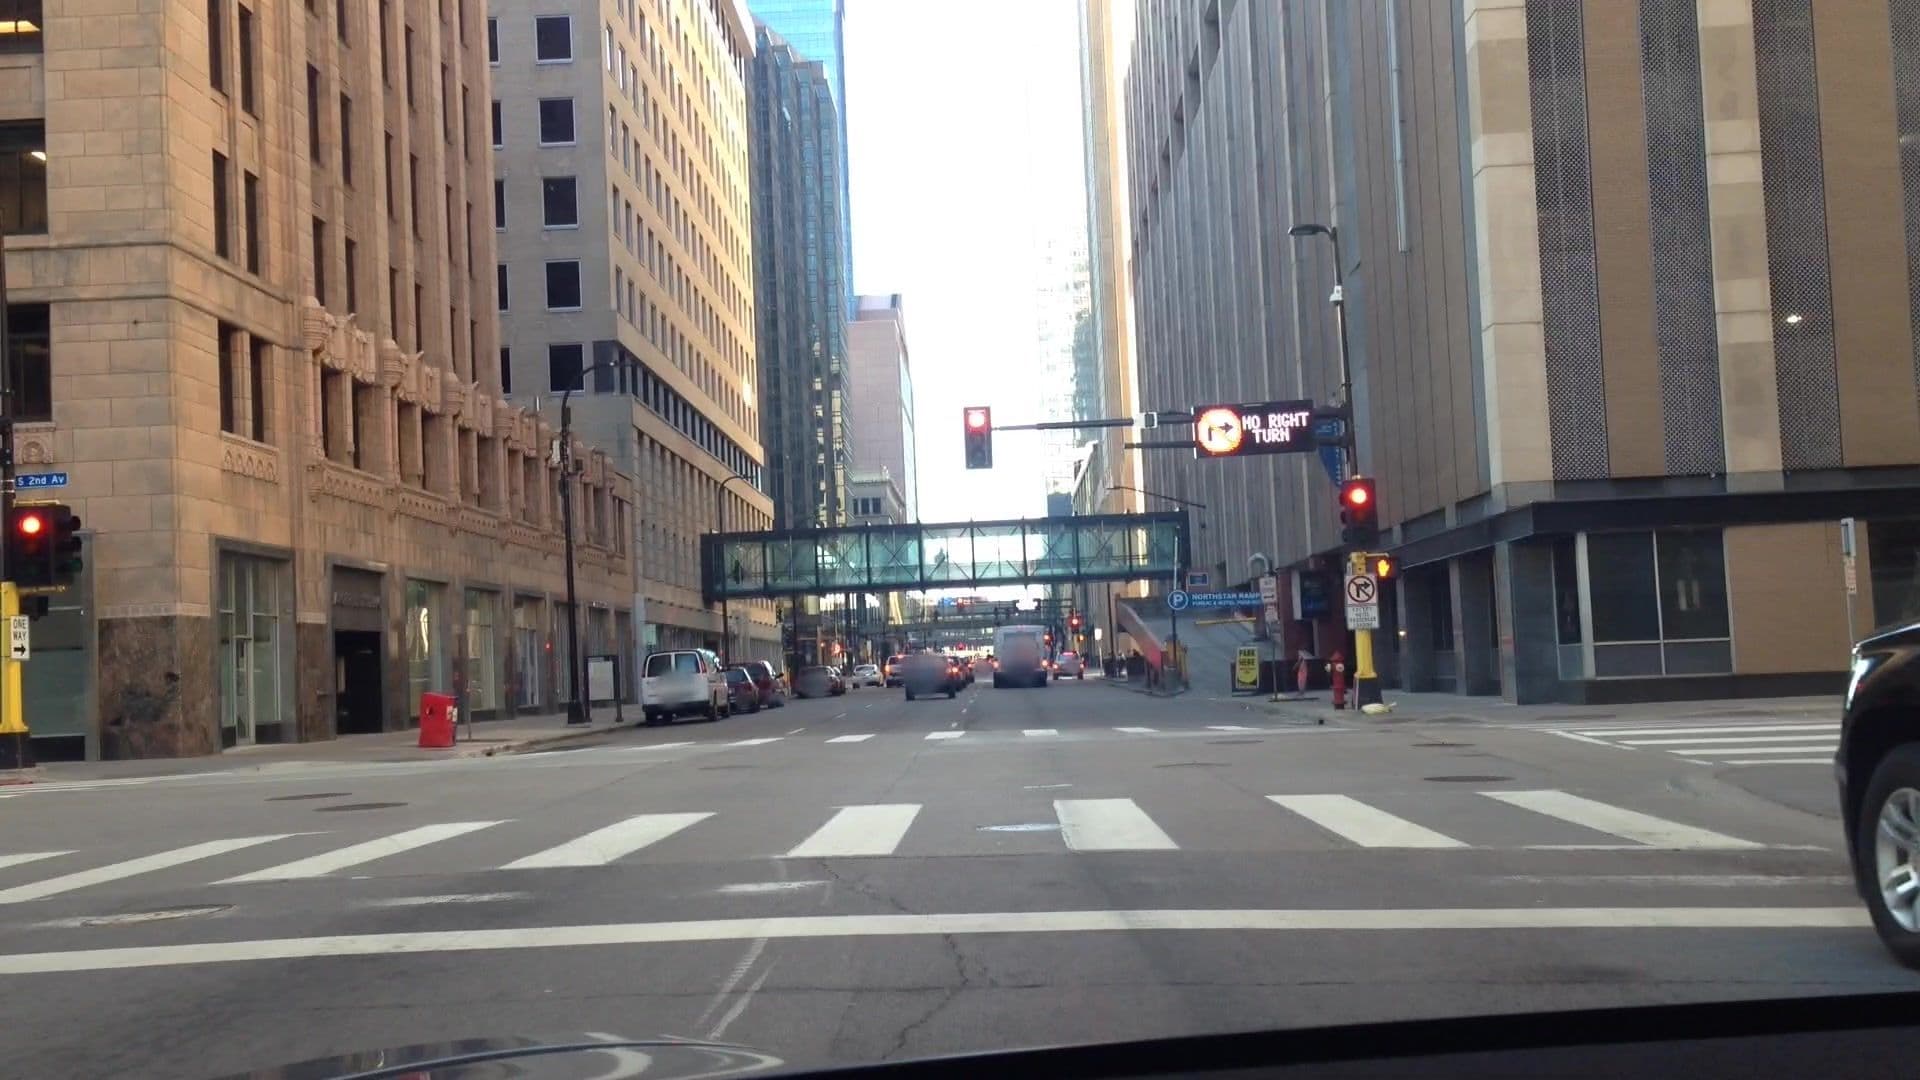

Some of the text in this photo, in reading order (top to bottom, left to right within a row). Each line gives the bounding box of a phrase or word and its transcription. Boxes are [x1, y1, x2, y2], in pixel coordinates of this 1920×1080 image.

[1268, 412, 1309, 428] RIGHT
[1252, 428, 1290, 443] TURN
[18, 474, 65, 486] S 2nd Av
[1173, 594, 1184, 606] P
[1192, 592, 1237, 600] NORTHSTAR
[13, 618, 26, 630] ONE
[13, 631, 26, 641] WAY
